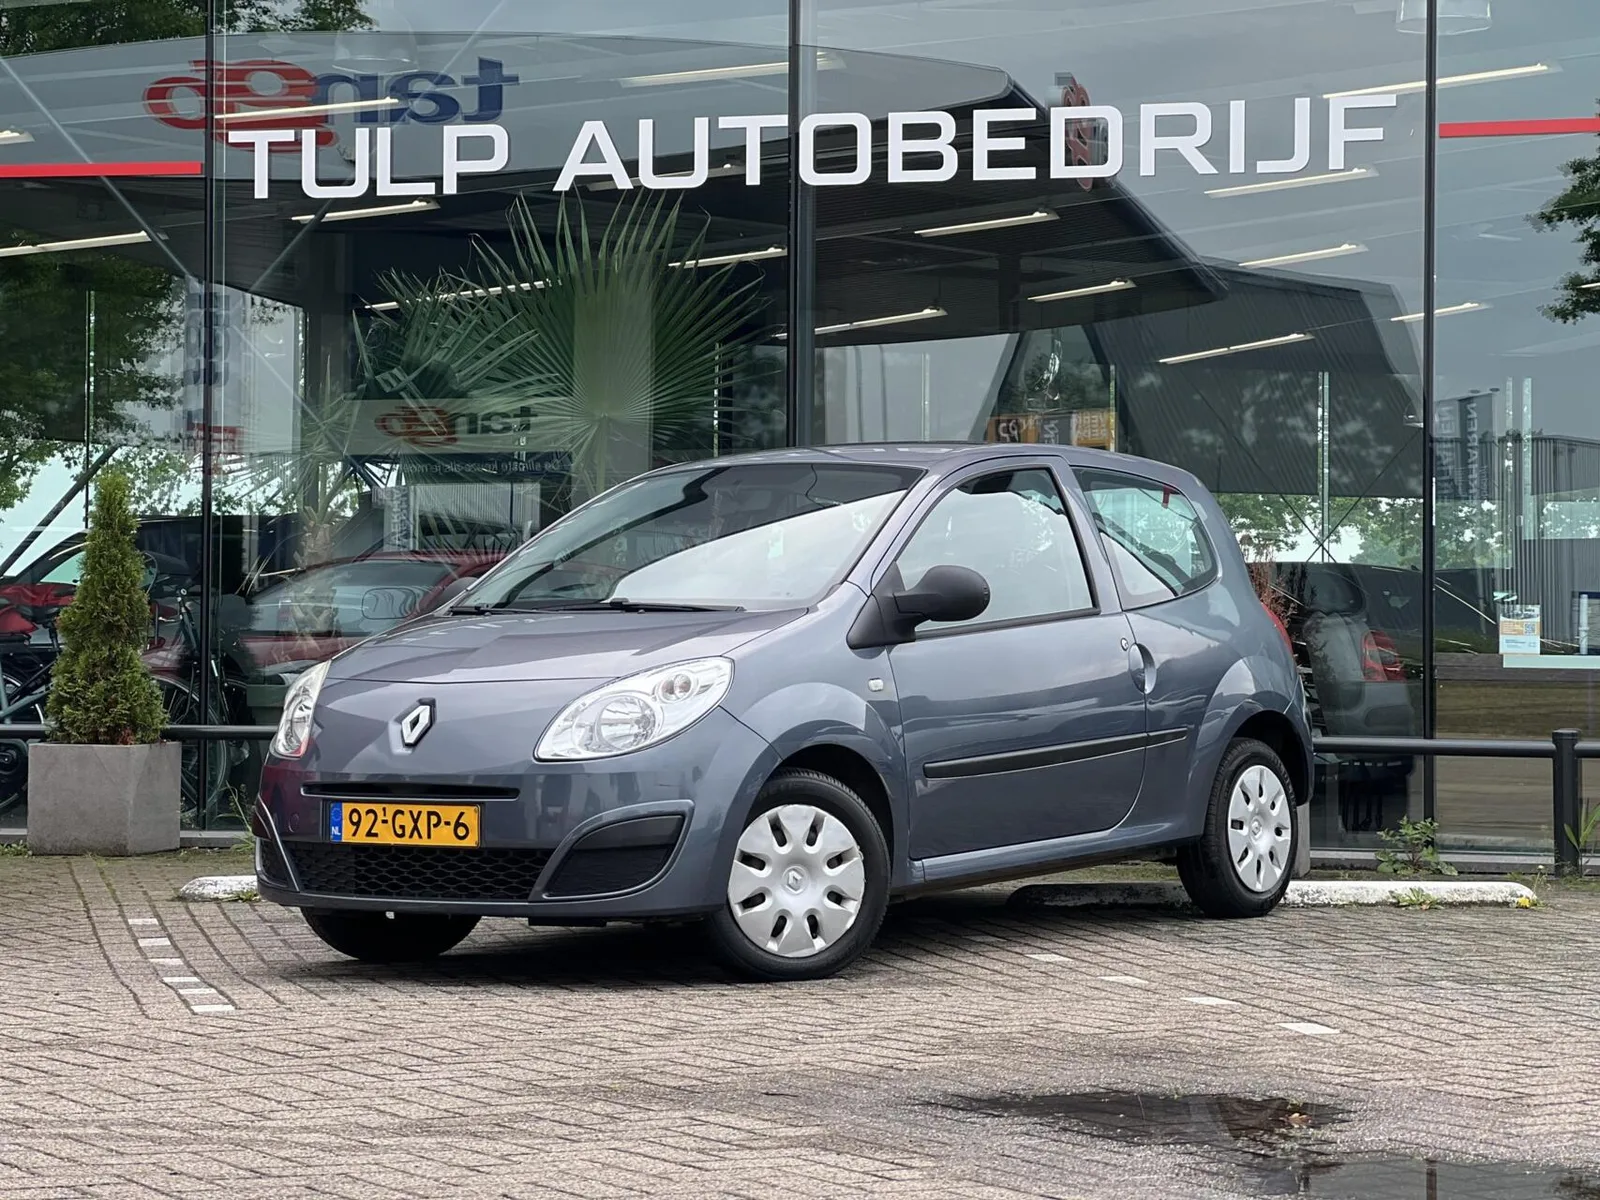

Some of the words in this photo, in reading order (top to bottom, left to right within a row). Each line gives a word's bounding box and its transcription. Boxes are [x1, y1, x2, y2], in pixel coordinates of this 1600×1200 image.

[228, 124, 508, 199] TULP
[553, 94, 1397, 192] AUTOBEDRIJF
[331, 827, 341, 836] NL
